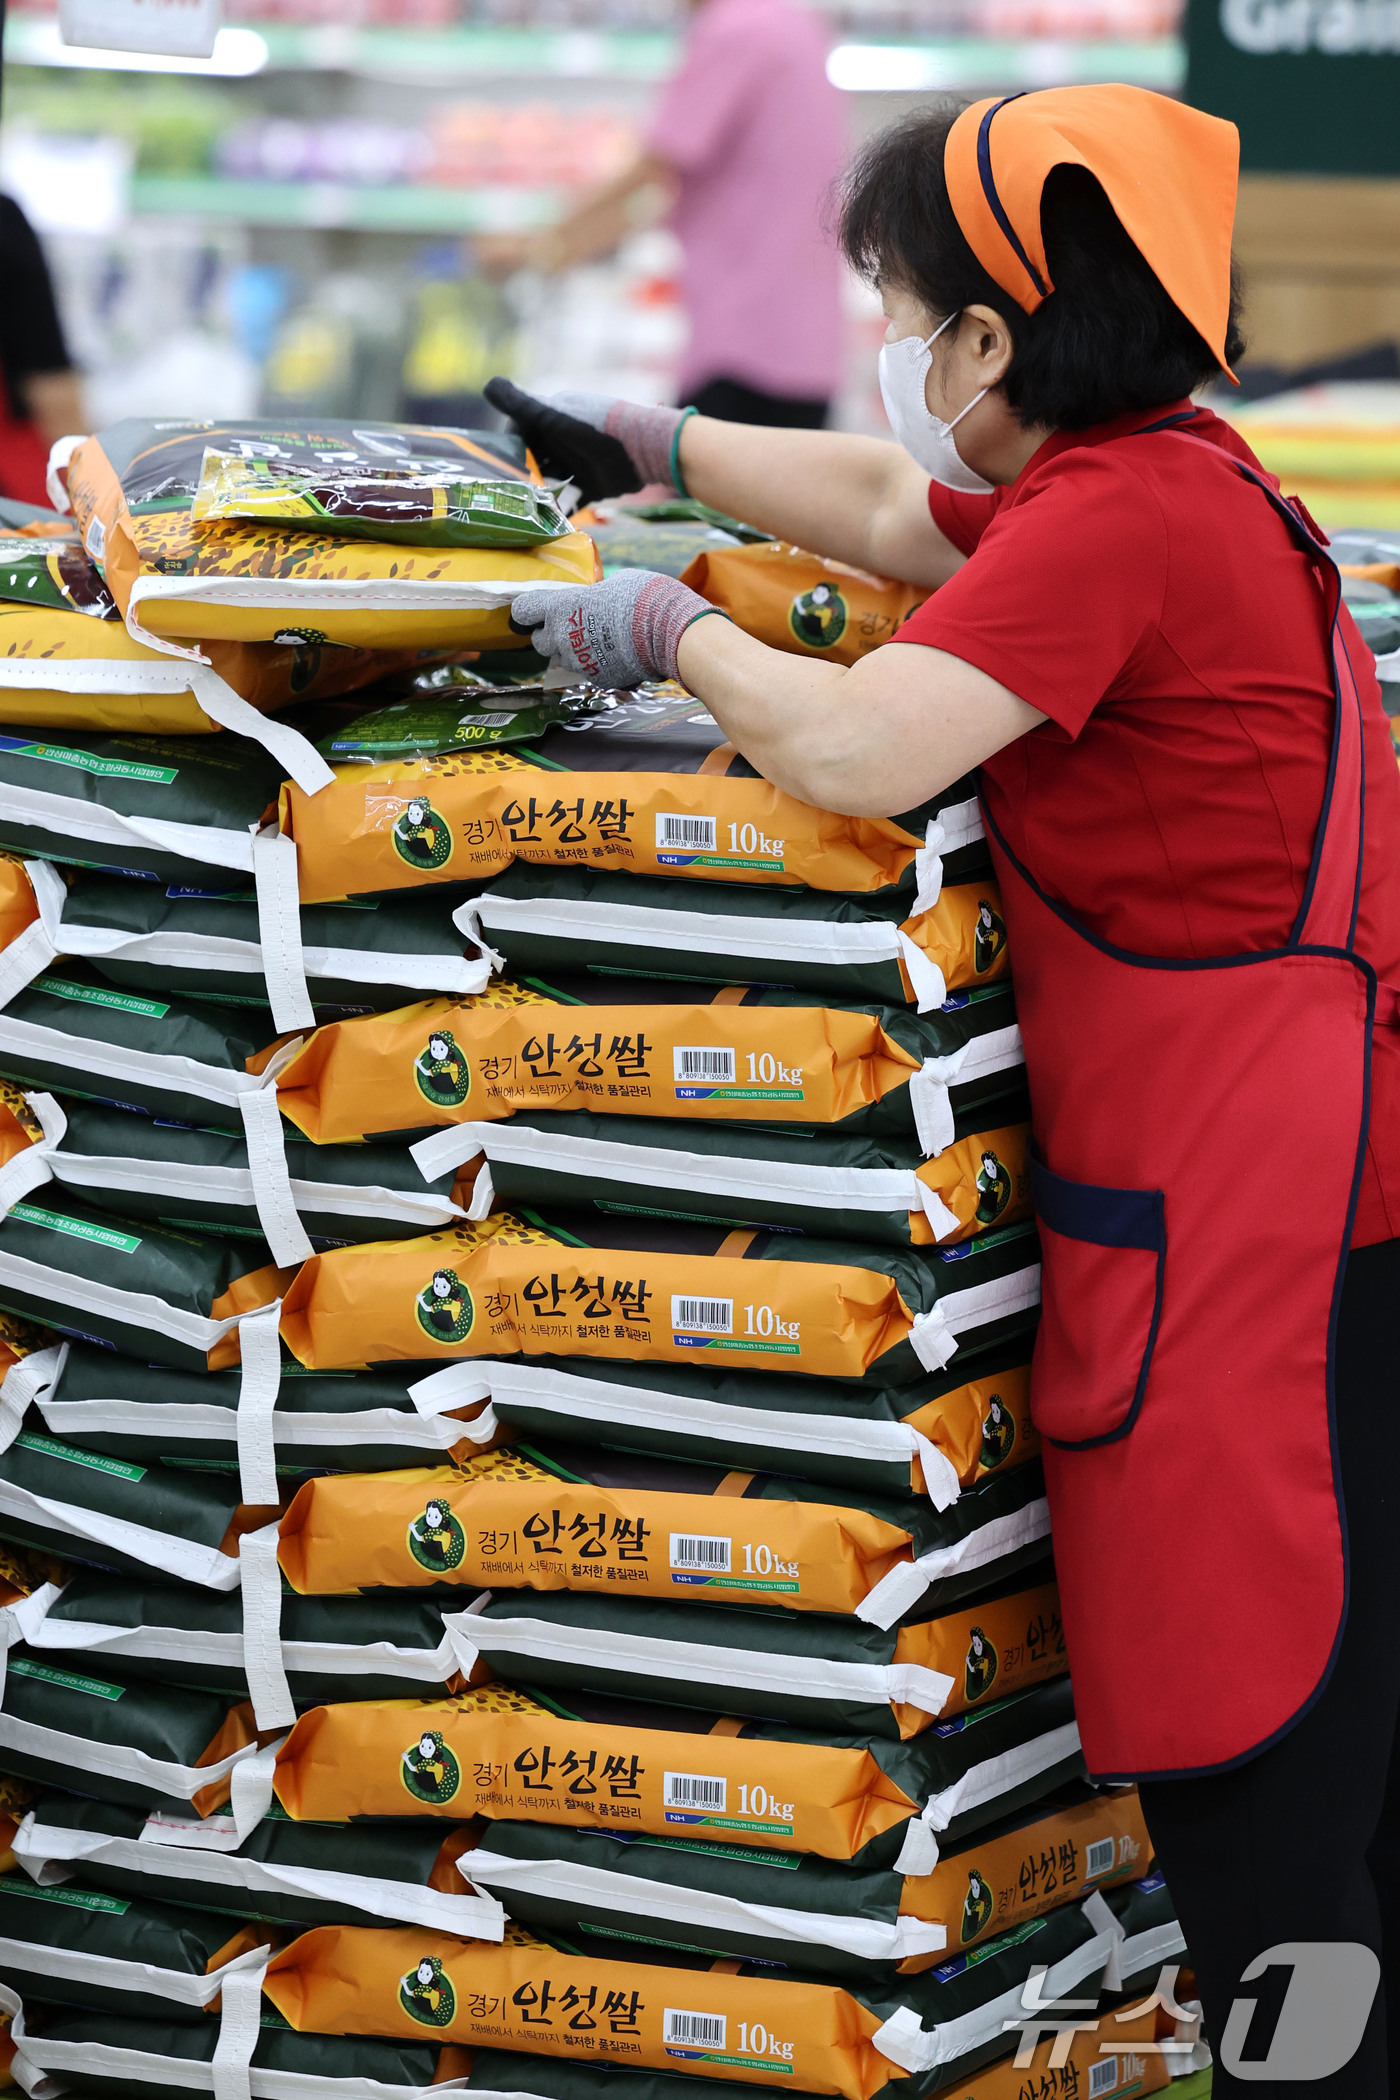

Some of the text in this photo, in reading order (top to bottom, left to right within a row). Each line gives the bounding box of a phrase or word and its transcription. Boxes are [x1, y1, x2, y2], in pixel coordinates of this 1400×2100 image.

[568, 608, 600, 677] 나이텍스
[588, 615, 596, 637] Glove
[455, 726, 502, 740] 500 g
[463, 798, 635, 845] 경기 안성쌀
[510, 848, 550, 859] 탁까지
[554, 849, 589, 859] 철저한
[592, 844, 635, 859] 품질관리
[727, 822, 785, 857] 10kg
[479, 1033, 652, 1080] 경기 안성쌀
[746, 1052, 802, 1086] 10kg
[529, 1084, 572, 1096] 식탁까지
[574, 1080, 603, 1095] 철저한
[608, 1084, 651, 1098] 품질관리
[485, 1273, 652, 1322] 경기 안성쌀
[490, 1322, 651, 1343] 재배서 식탁까지 철저한 품질관리
[744, 1305, 800, 1340] 10kg
[478, 1510, 650, 1562] 경기 안성쌀
[481, 1560, 649, 1581] 재배에서 식탁까지 철저한 품질관리
[742, 1543, 799, 1578] 10kg
[1004, 1643, 1025, 1672] 경기
[473, 1746, 645, 1799] 경기 안성쌀
[475, 1793, 641, 1819] 재배에서 식탁까지 철저한 품질관리
[737, 1784, 794, 1821] 10kg
[998, 1884, 1017, 1913] 경기
[1019, 1839, 1078, 1902] 안성쌀
[468, 1994, 506, 2020] 경기
[513, 1980, 645, 2035] 안성쌀
[471, 2024, 641, 2053] 재배에서 식탁까지 철저한 품질관리
[699, 2039, 719, 2047] 150050
[737, 2022, 794, 2060] 10kg
